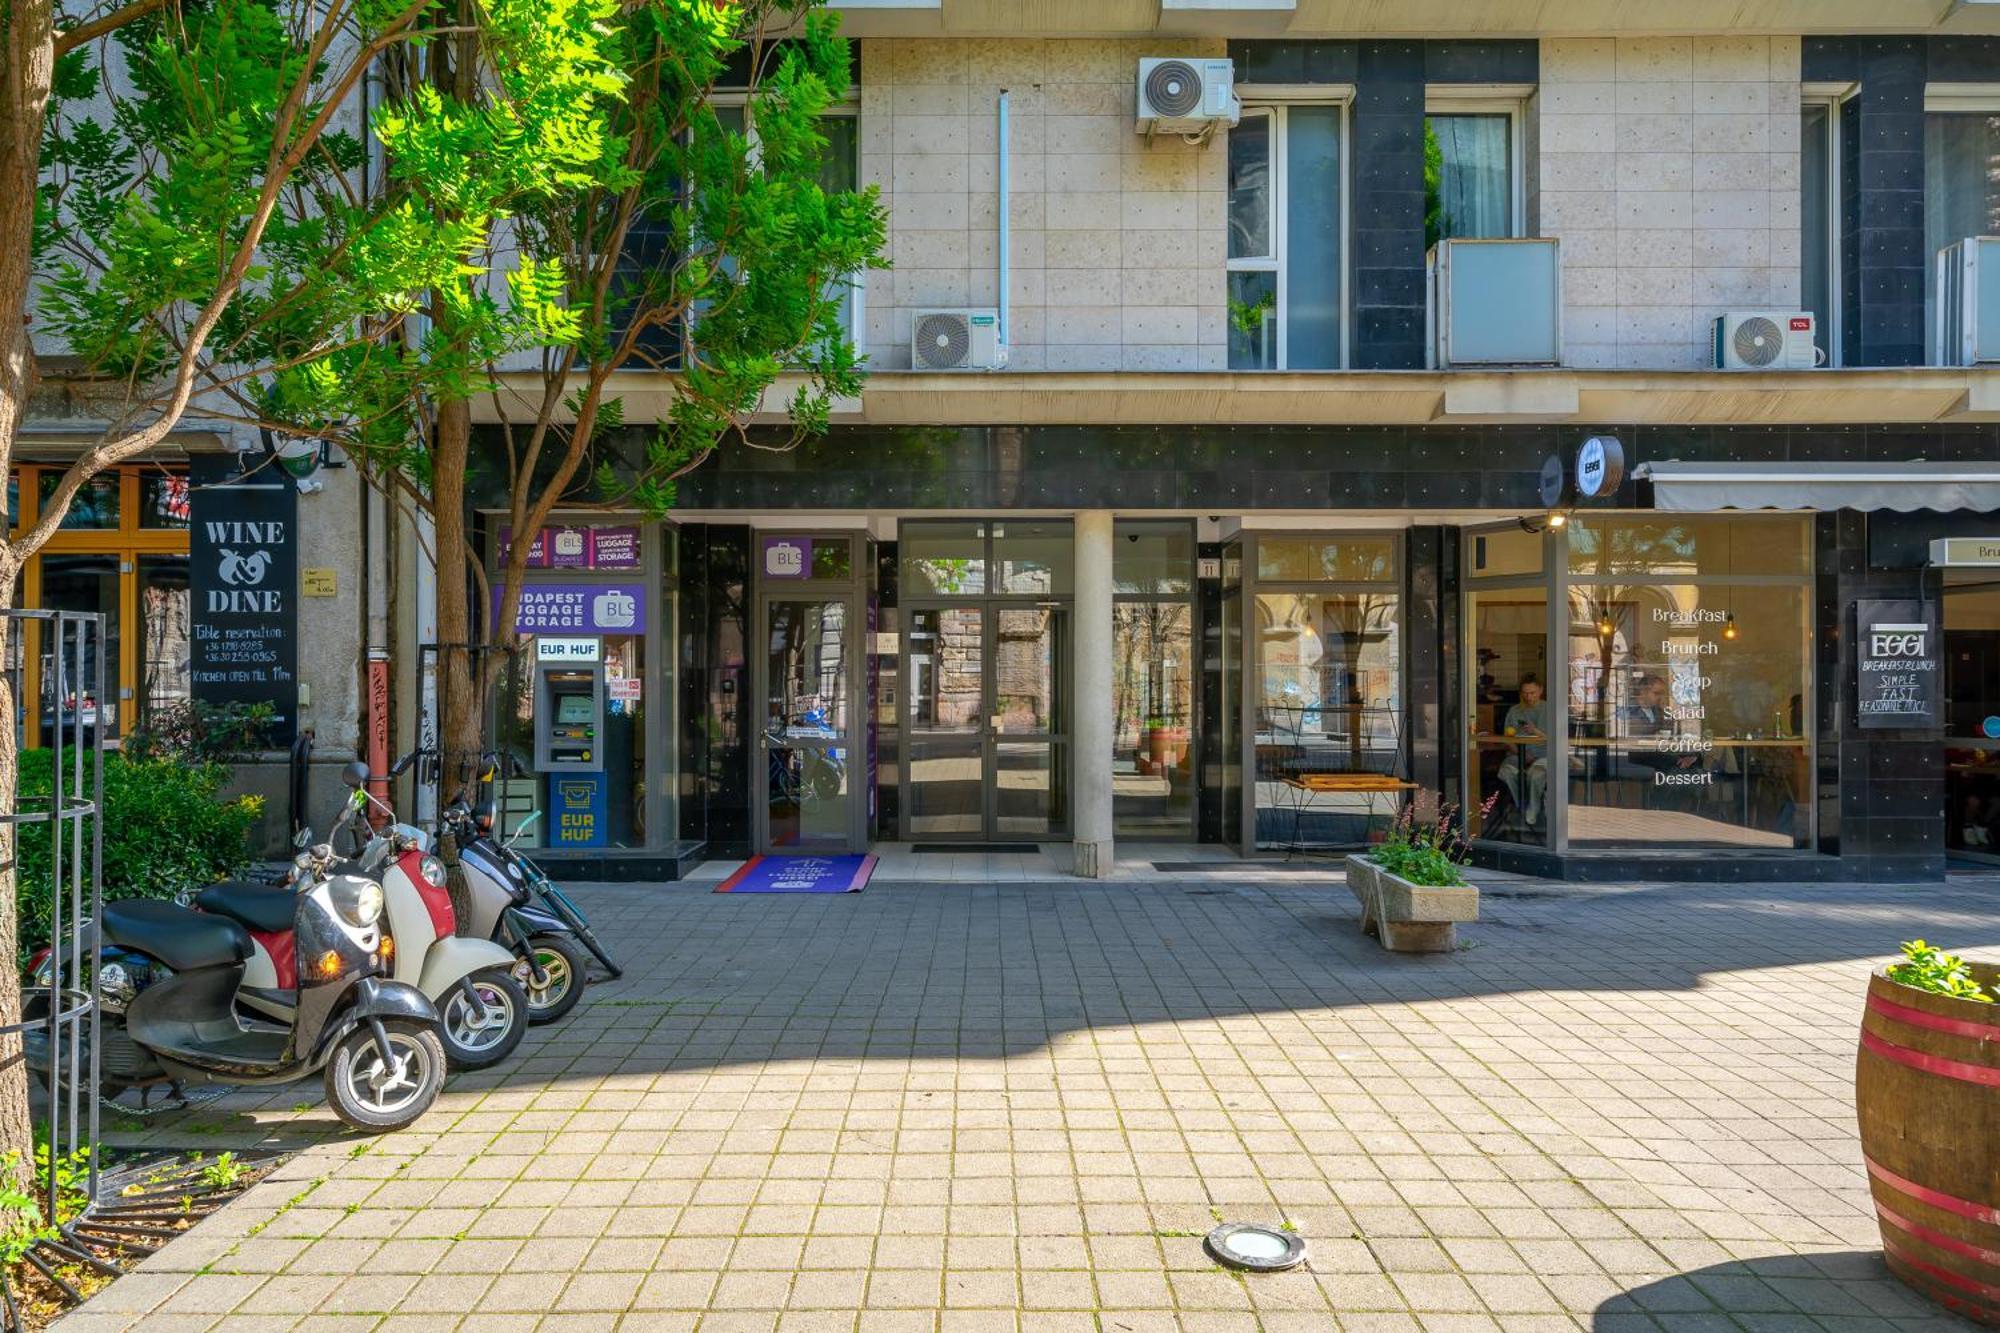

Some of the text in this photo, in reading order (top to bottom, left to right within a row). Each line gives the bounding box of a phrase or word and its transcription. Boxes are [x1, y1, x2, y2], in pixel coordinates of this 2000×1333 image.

[1793, 320, 1809, 329] TCL
[206, 522, 285, 544] WINE
[597, 539, 633, 548] LUGGAGE
[778, 552, 802, 565] BLS
[207, 590, 282, 613] DINE
[519, 593, 584, 604] DAPEST
[517, 605, 584, 615] GGAGE
[607, 602, 635, 616] BLS
[1652, 608, 1726, 622] Breakfast
[515, 616, 583, 626] TORAGE
[193, 624, 220, 640] Table
[541, 645, 595, 655] EUR HUF
[1662, 641, 1718, 654] Brunch
[1871, 634, 1925, 657] EGGI
[192, 671, 227, 682] KITCHEN
[229, 671, 250, 682] OPEN
[252, 669, 267, 681] TILL
[1672, 674, 1713, 690] up
[1880, 674, 1917, 688] SIMPLE
[1882, 688, 1918, 701] FAST
[1663, 706, 1705, 720] Salad
[1658, 739, 1713, 753] Coffee
[1655, 771, 1714, 786] Dessert
[560, 814, 594, 826] EUR
[560, 829, 594, 841] HUF
